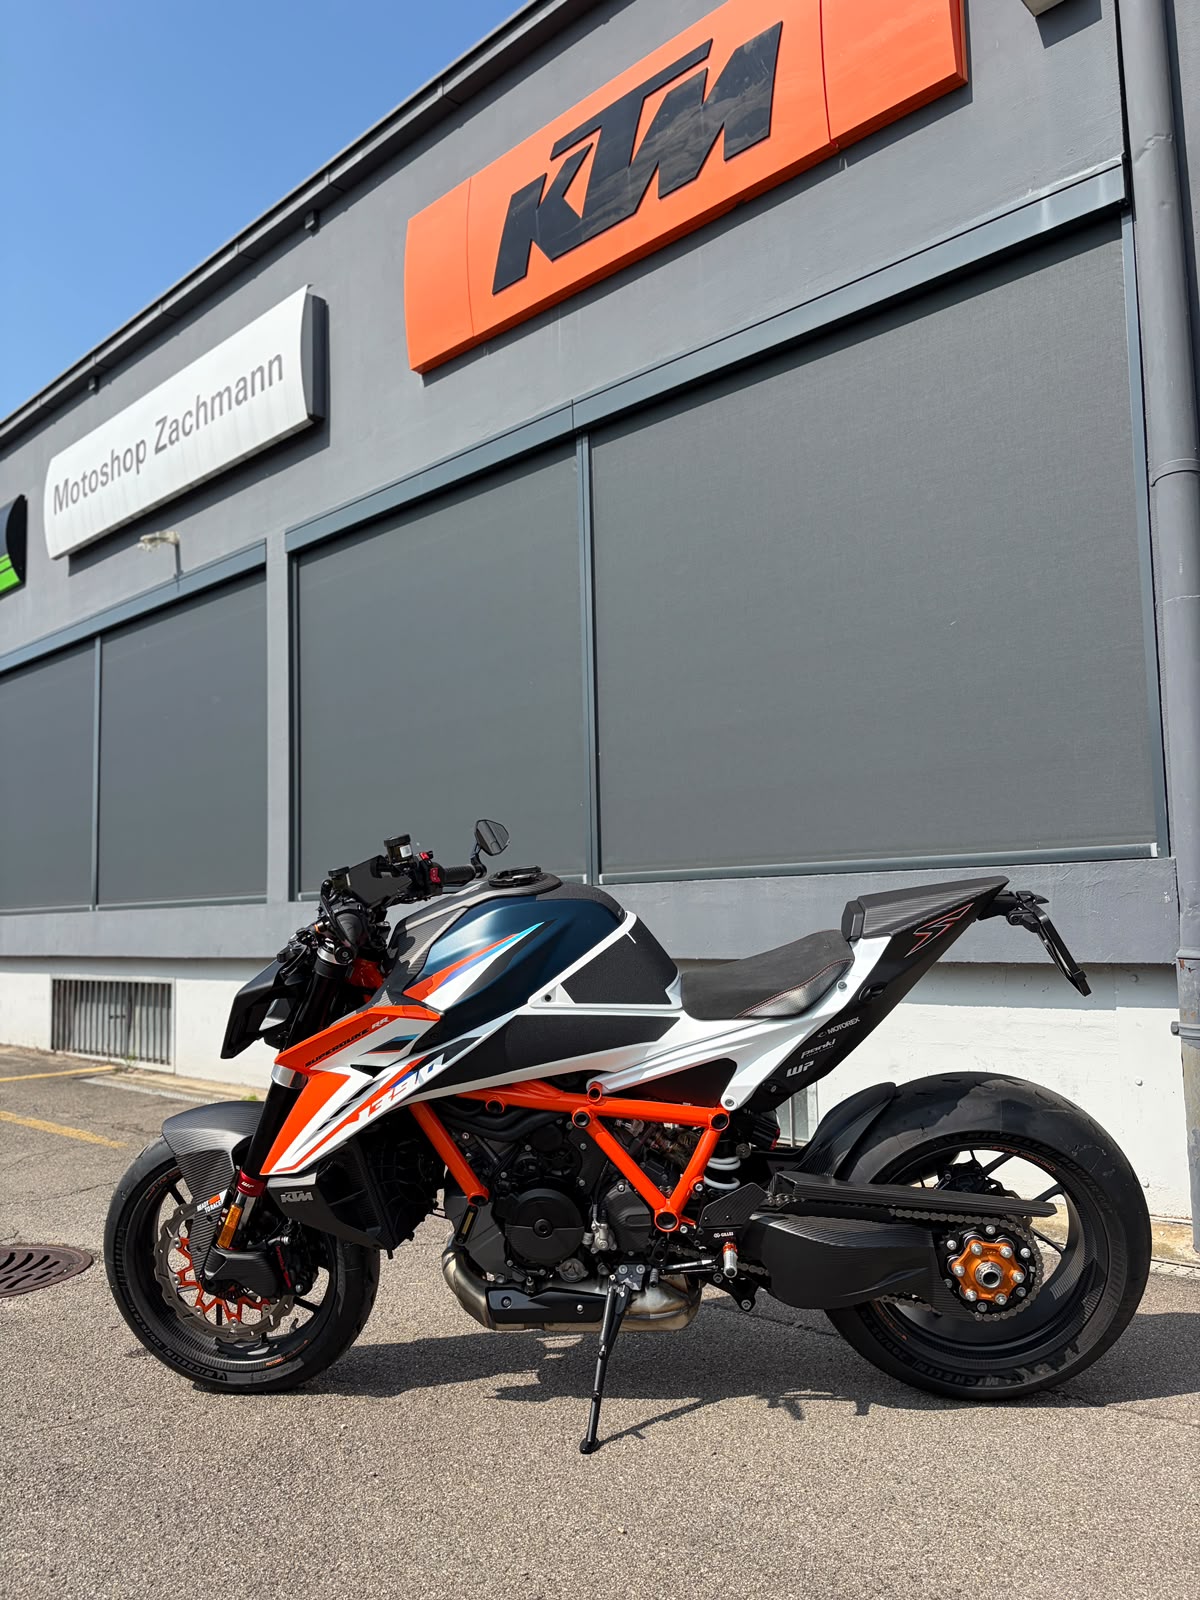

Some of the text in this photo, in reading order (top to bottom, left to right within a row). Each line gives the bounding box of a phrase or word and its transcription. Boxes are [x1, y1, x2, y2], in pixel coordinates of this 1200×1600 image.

[492, 21, 783, 295] KTM
[53, 353, 283, 515] Motoshop Zachmann
[827, 1016, 860, 1034] MOTOREX
[786, 1060, 814, 1077] WP
[280, 1190, 314, 1203] KTM
